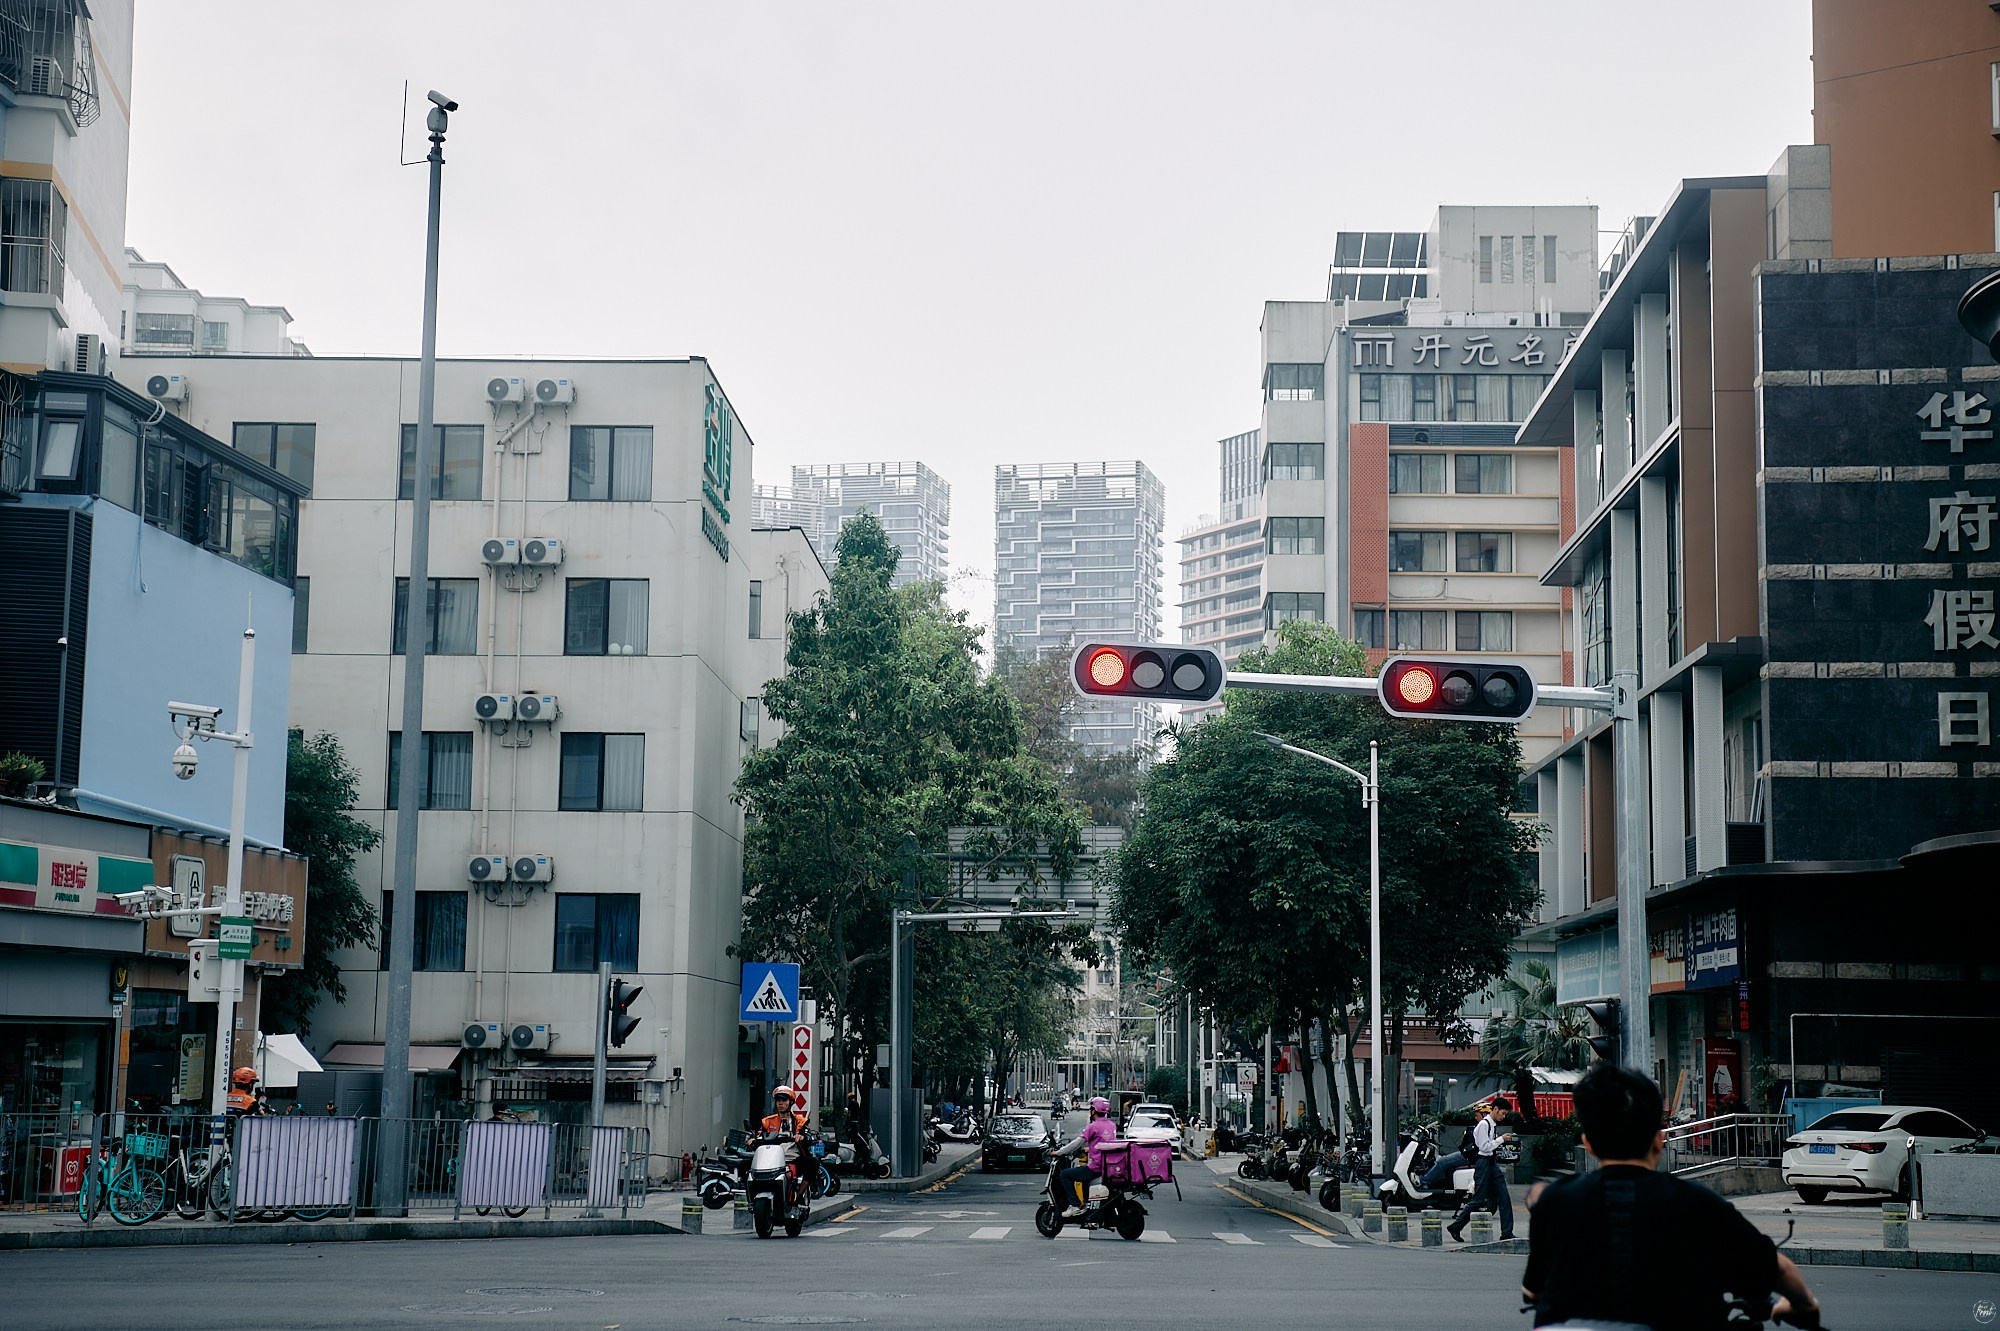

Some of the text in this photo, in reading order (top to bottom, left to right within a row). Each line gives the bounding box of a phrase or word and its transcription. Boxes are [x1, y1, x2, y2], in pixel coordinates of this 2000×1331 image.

[1916, 390, 2000, 746] 华府假日
[1695, 908, 1737, 947] 兰州牛肉面
[1739, 981, 1750, 1030] 兰州牛肉面
